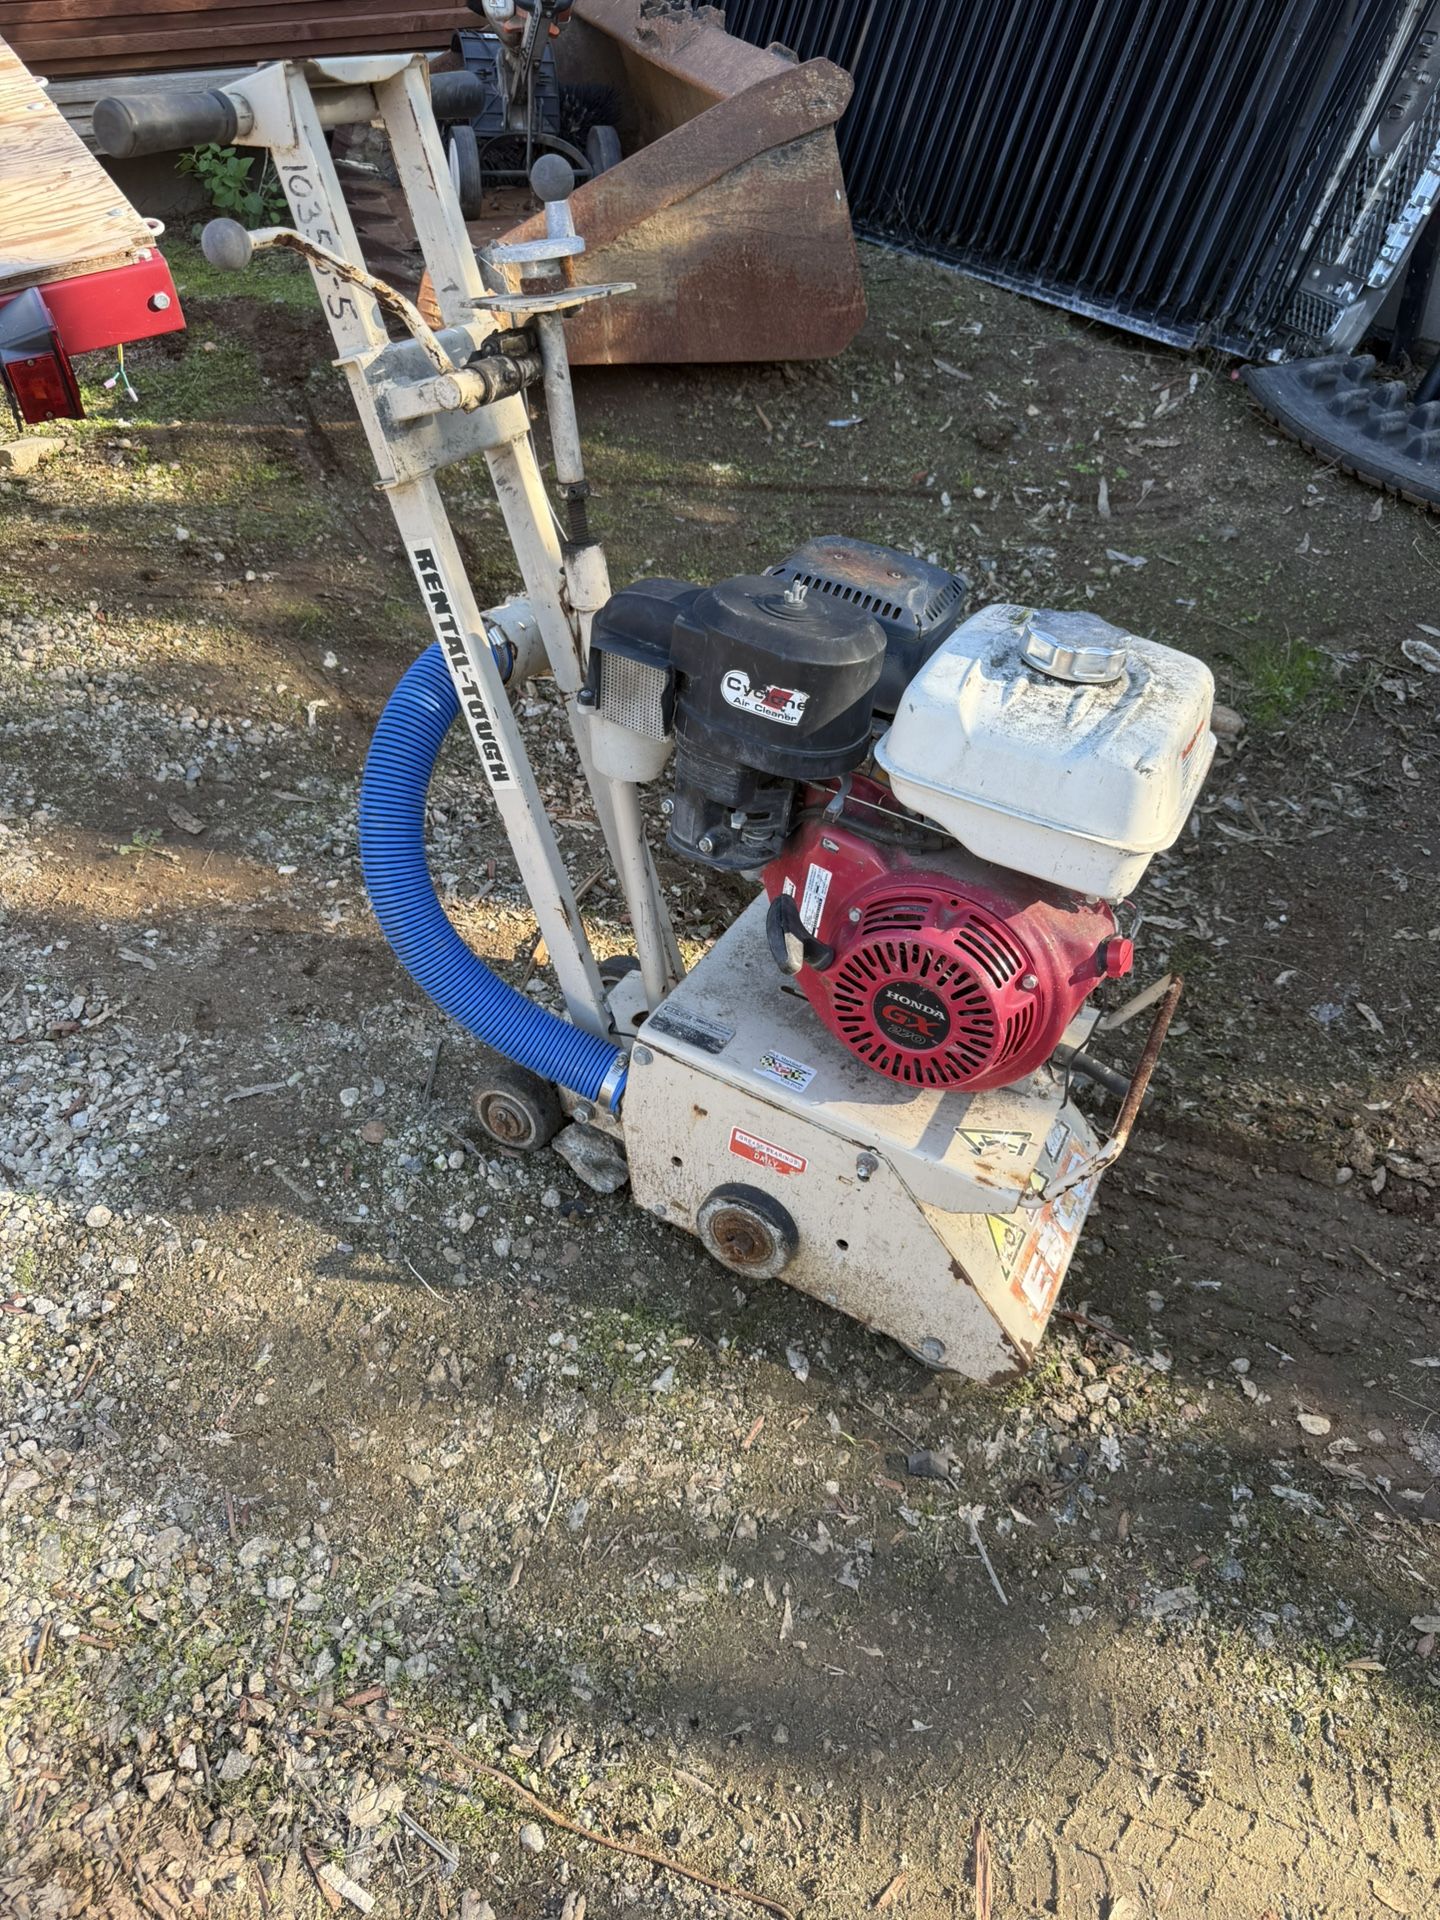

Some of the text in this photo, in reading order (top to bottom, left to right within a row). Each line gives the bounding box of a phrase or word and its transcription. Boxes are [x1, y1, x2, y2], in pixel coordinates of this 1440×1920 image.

[282, 165, 358, 320] 1035-5
[413, 548, 510, 783] RENTAL-TOUGH
[733, 697, 797, 722] Air Cleaner
[882, 1004, 941, 1037] GX
[885, 990, 946, 1021] HONDA
[887, 1023, 927, 1045] 270
[754, 1150, 779, 1169] DAILY
